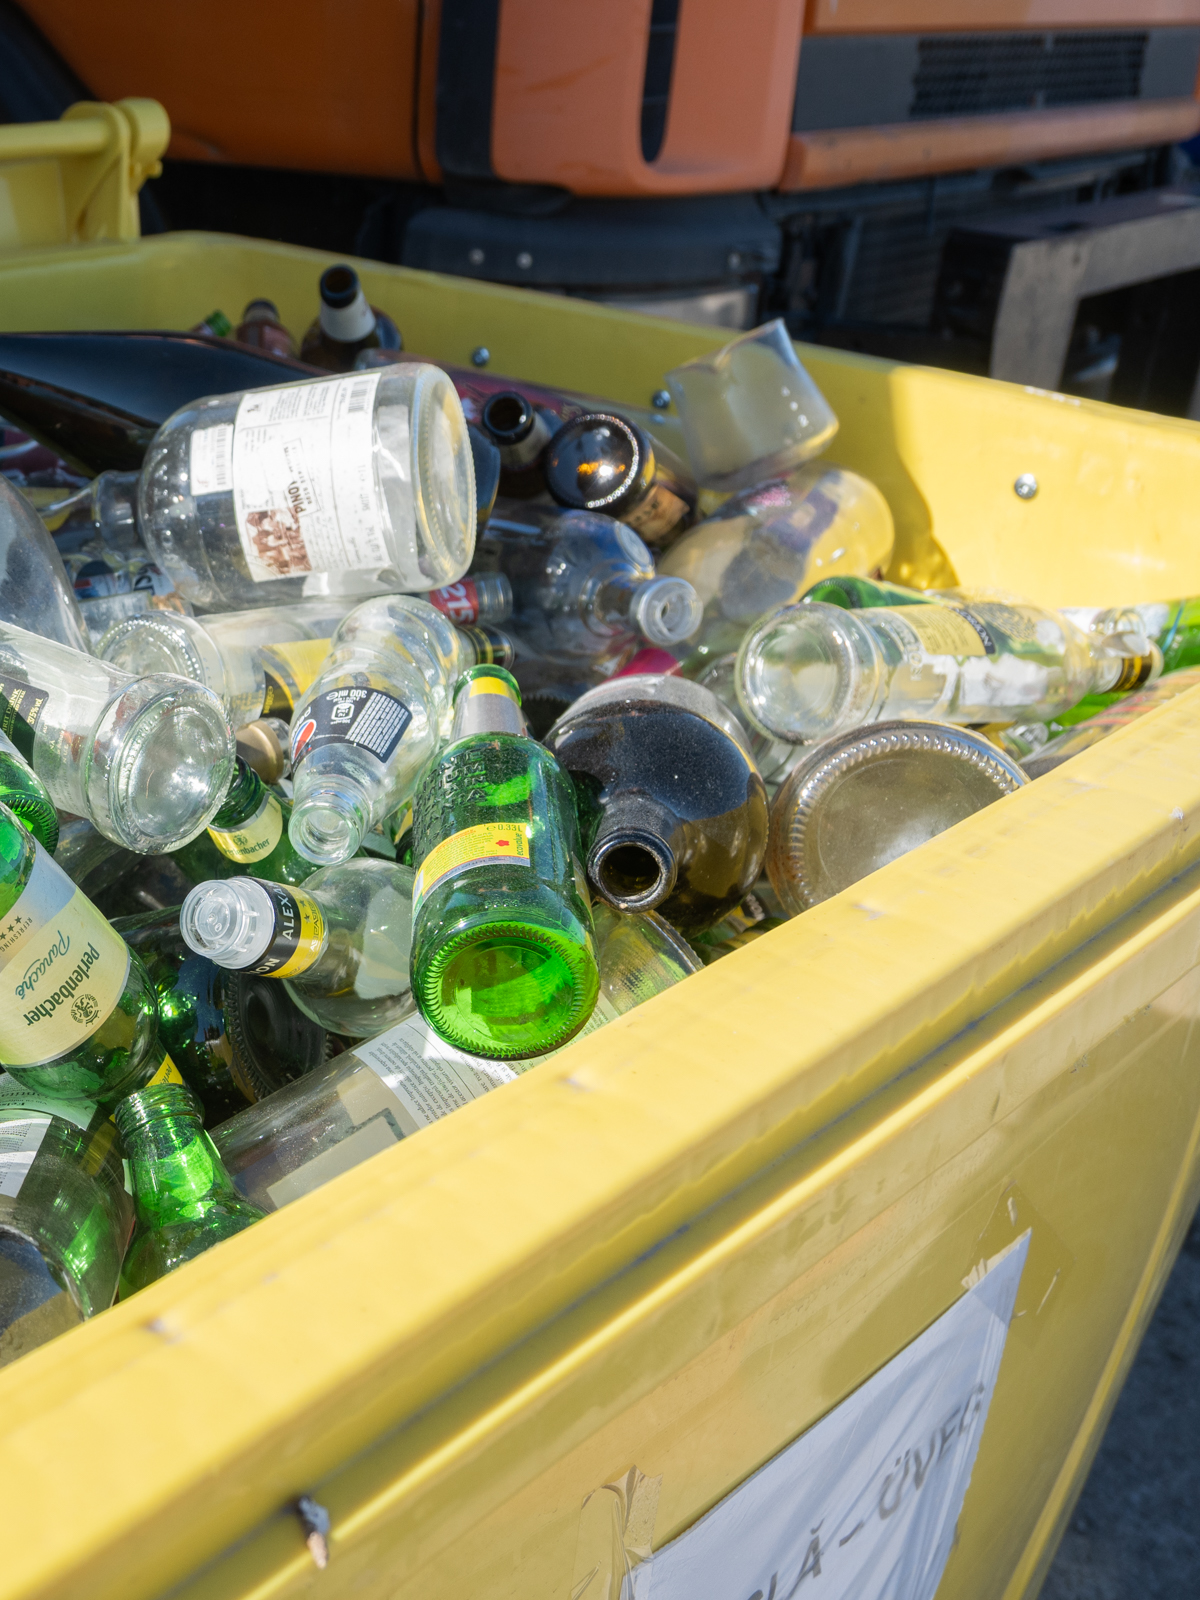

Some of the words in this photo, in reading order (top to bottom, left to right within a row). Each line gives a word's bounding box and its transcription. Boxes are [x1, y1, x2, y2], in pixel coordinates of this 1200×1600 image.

[348, 689, 368, 697] 300
[0, 917, 33, 953] REFRESHING
[15, 929, 70, 1000] Panaché
[23, 942, 100, 1027] Perlenbacher
[412, 1098, 426, 1115] aduce
